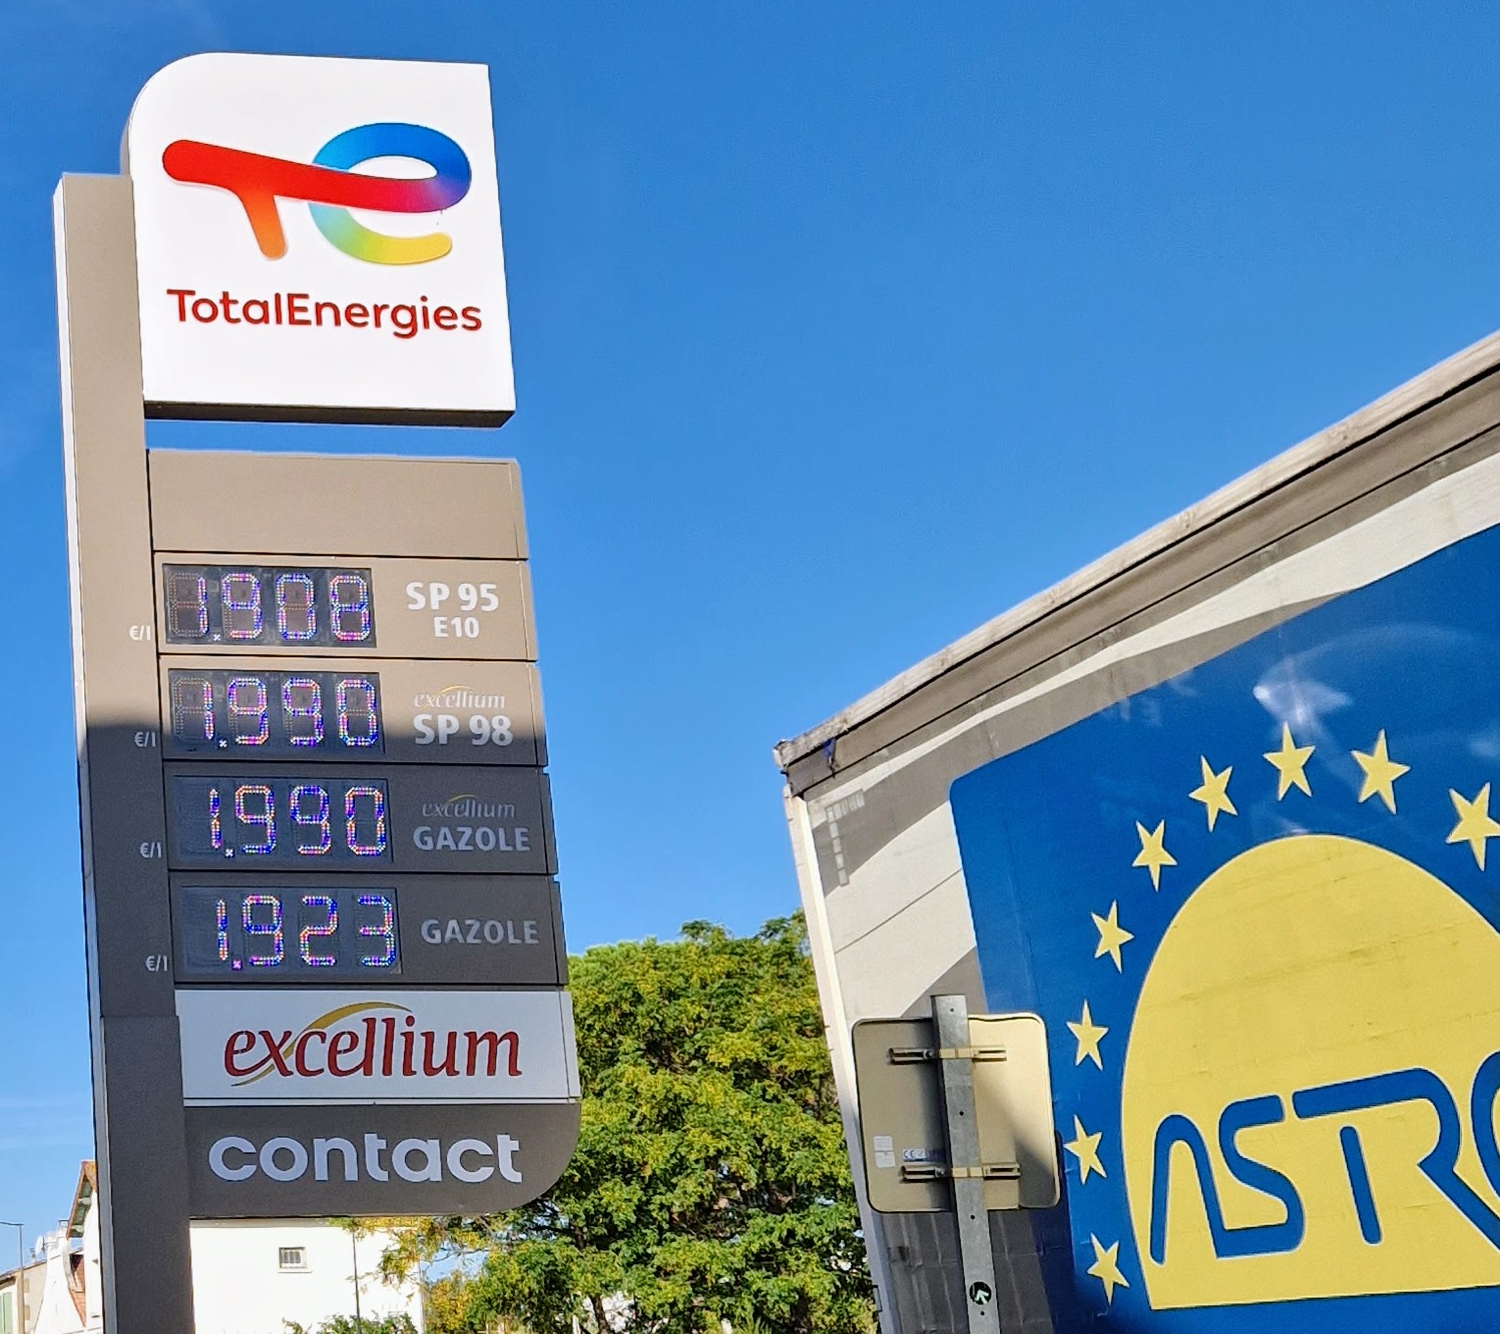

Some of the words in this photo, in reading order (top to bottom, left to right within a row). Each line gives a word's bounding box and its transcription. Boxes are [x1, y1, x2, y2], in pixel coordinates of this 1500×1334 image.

[166, 288, 483, 340] TotalEnergies
[197, 573, 370, 642] 1.908
[406, 581, 450, 610] SP
[458, 583, 499, 612] 95
[433, 616, 480, 639] E10
[203, 677, 379, 748] 1.990
[414, 690, 506, 709] excellium
[413, 713, 460, 745] SP
[469, 714, 514, 747] 98
[209, 784, 387, 859] 1.990
[422, 799, 515, 818] excellium
[413, 825, 531, 851] GAZOLE
[216, 895, 397, 970] 1.923
[420, 919, 540, 945] GAZOLE
[223, 1014, 523, 1078] excellium
[208, 1132, 523, 1184] contact
[1150, 1049, 1500, 1267] ASTR
